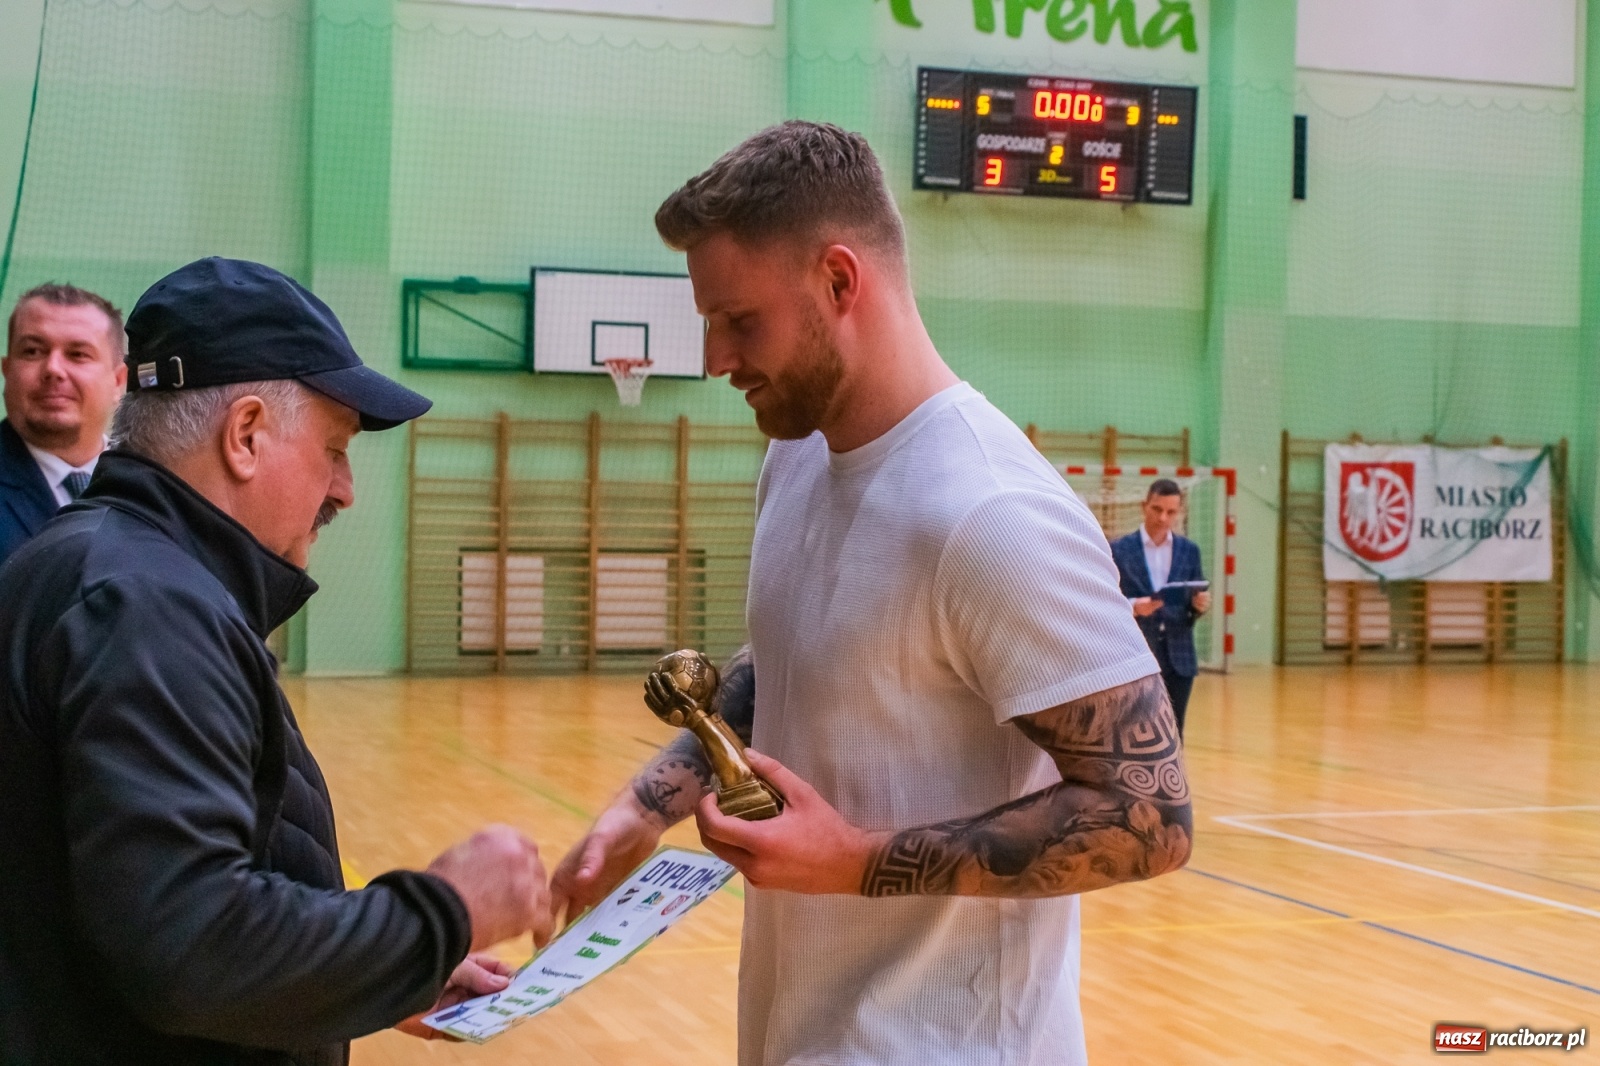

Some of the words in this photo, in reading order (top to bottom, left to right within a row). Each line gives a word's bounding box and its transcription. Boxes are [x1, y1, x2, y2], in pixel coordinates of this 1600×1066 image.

[977, 133, 1047, 153] GOSPODARZE
[1050, 145, 1064, 165] 2
[985, 158, 1003, 186] 3
[1100, 165, 1117, 193] 5
[1434, 486, 1527, 507] MIASTO
[639, 859, 717, 893] DYPLOM
